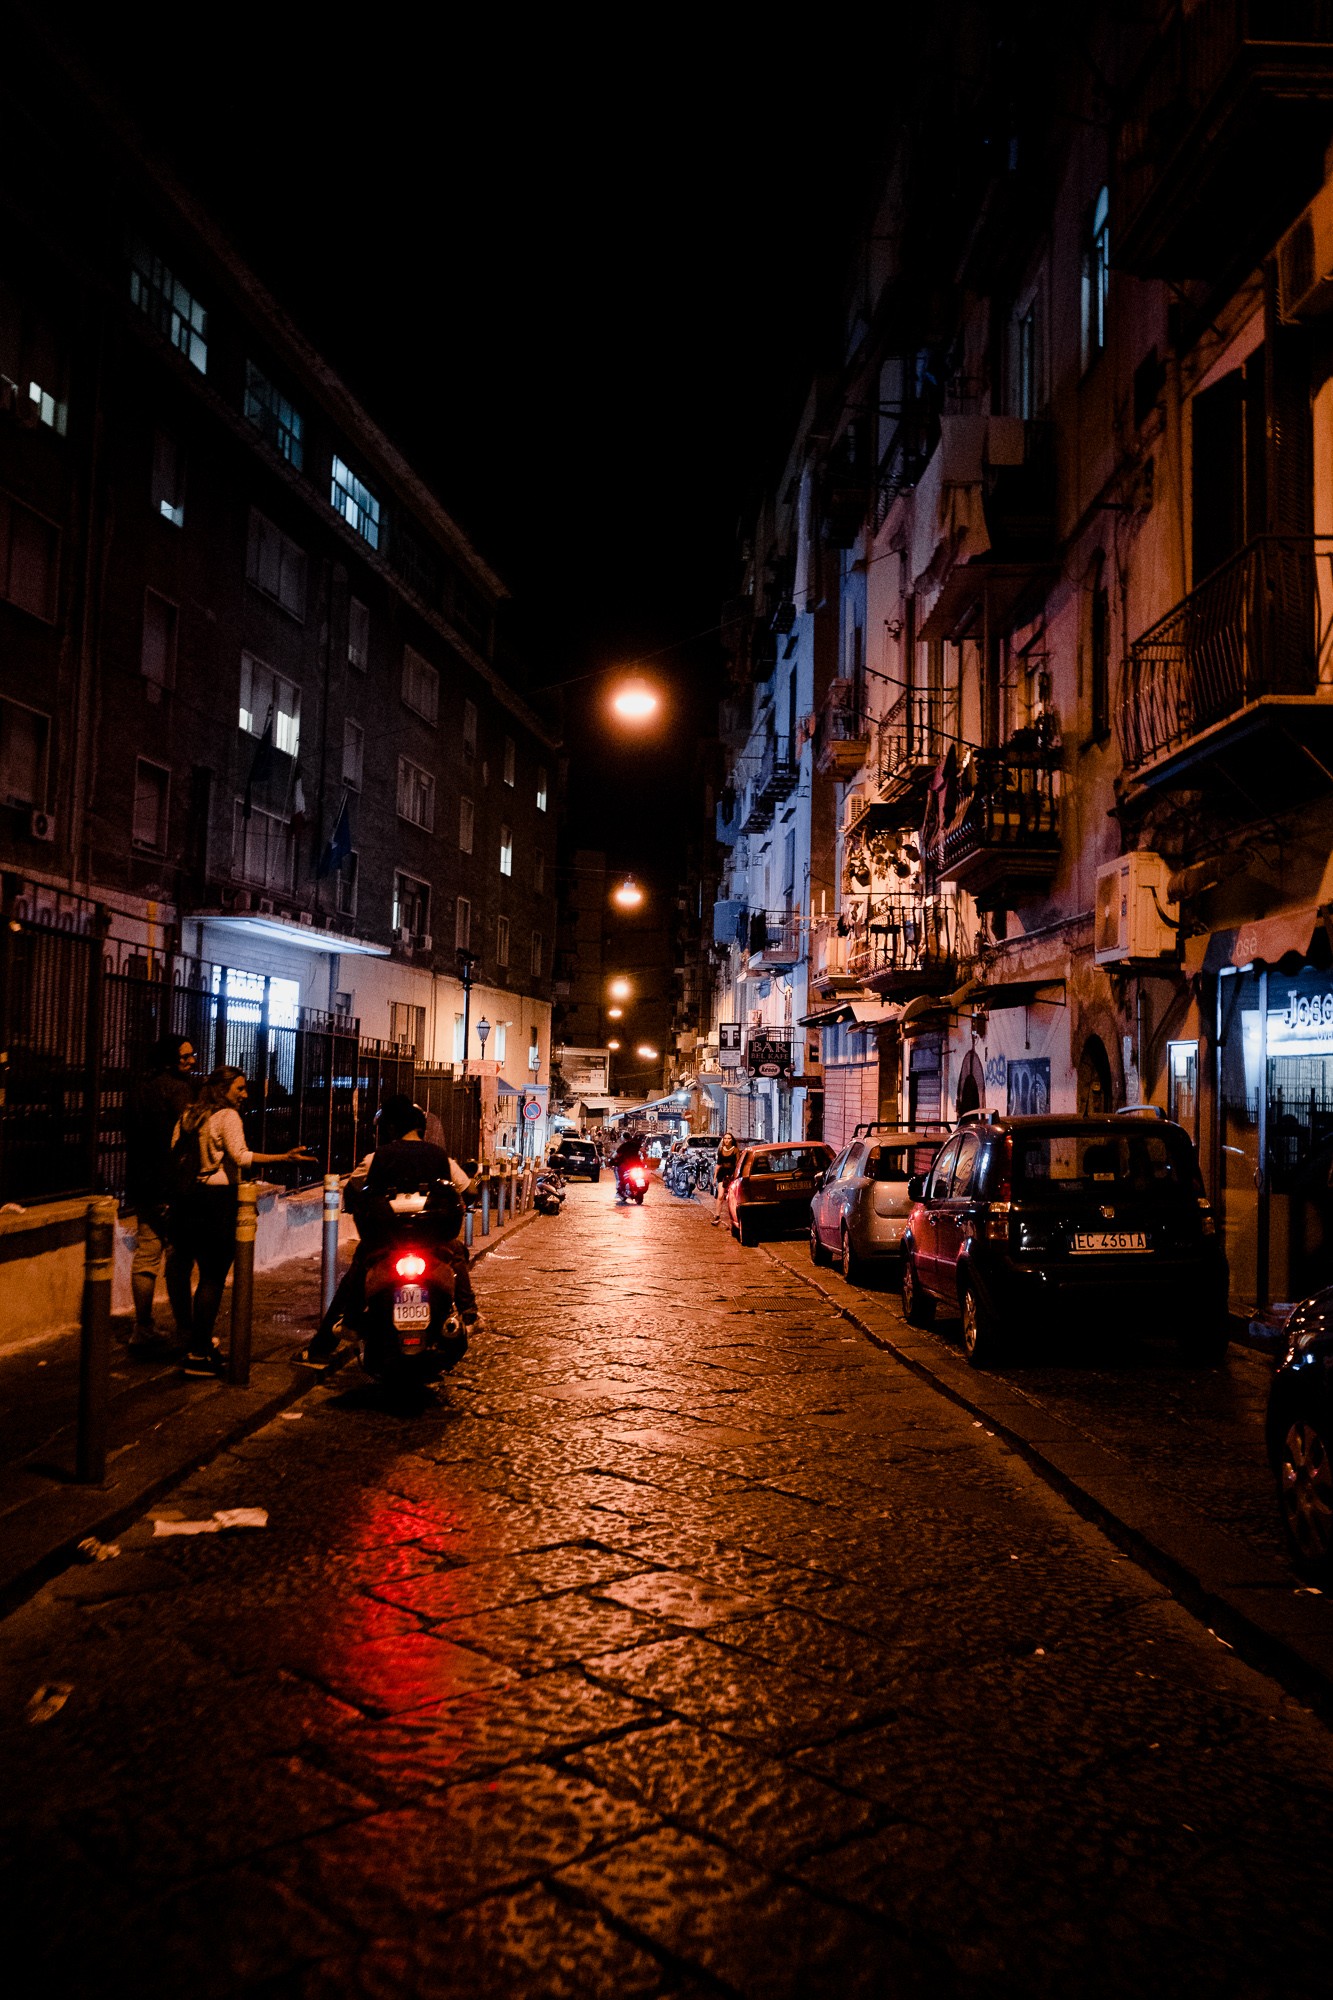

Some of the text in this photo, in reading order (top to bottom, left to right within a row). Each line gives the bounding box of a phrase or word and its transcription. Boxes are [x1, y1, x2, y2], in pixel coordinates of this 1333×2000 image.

[752, 1041, 788, 1053] BAR
[1077, 1233, 1144, 1248] EC 436TA
[402, 1290, 415, 1303] DV
[397, 1306, 428, 1319] 18060
